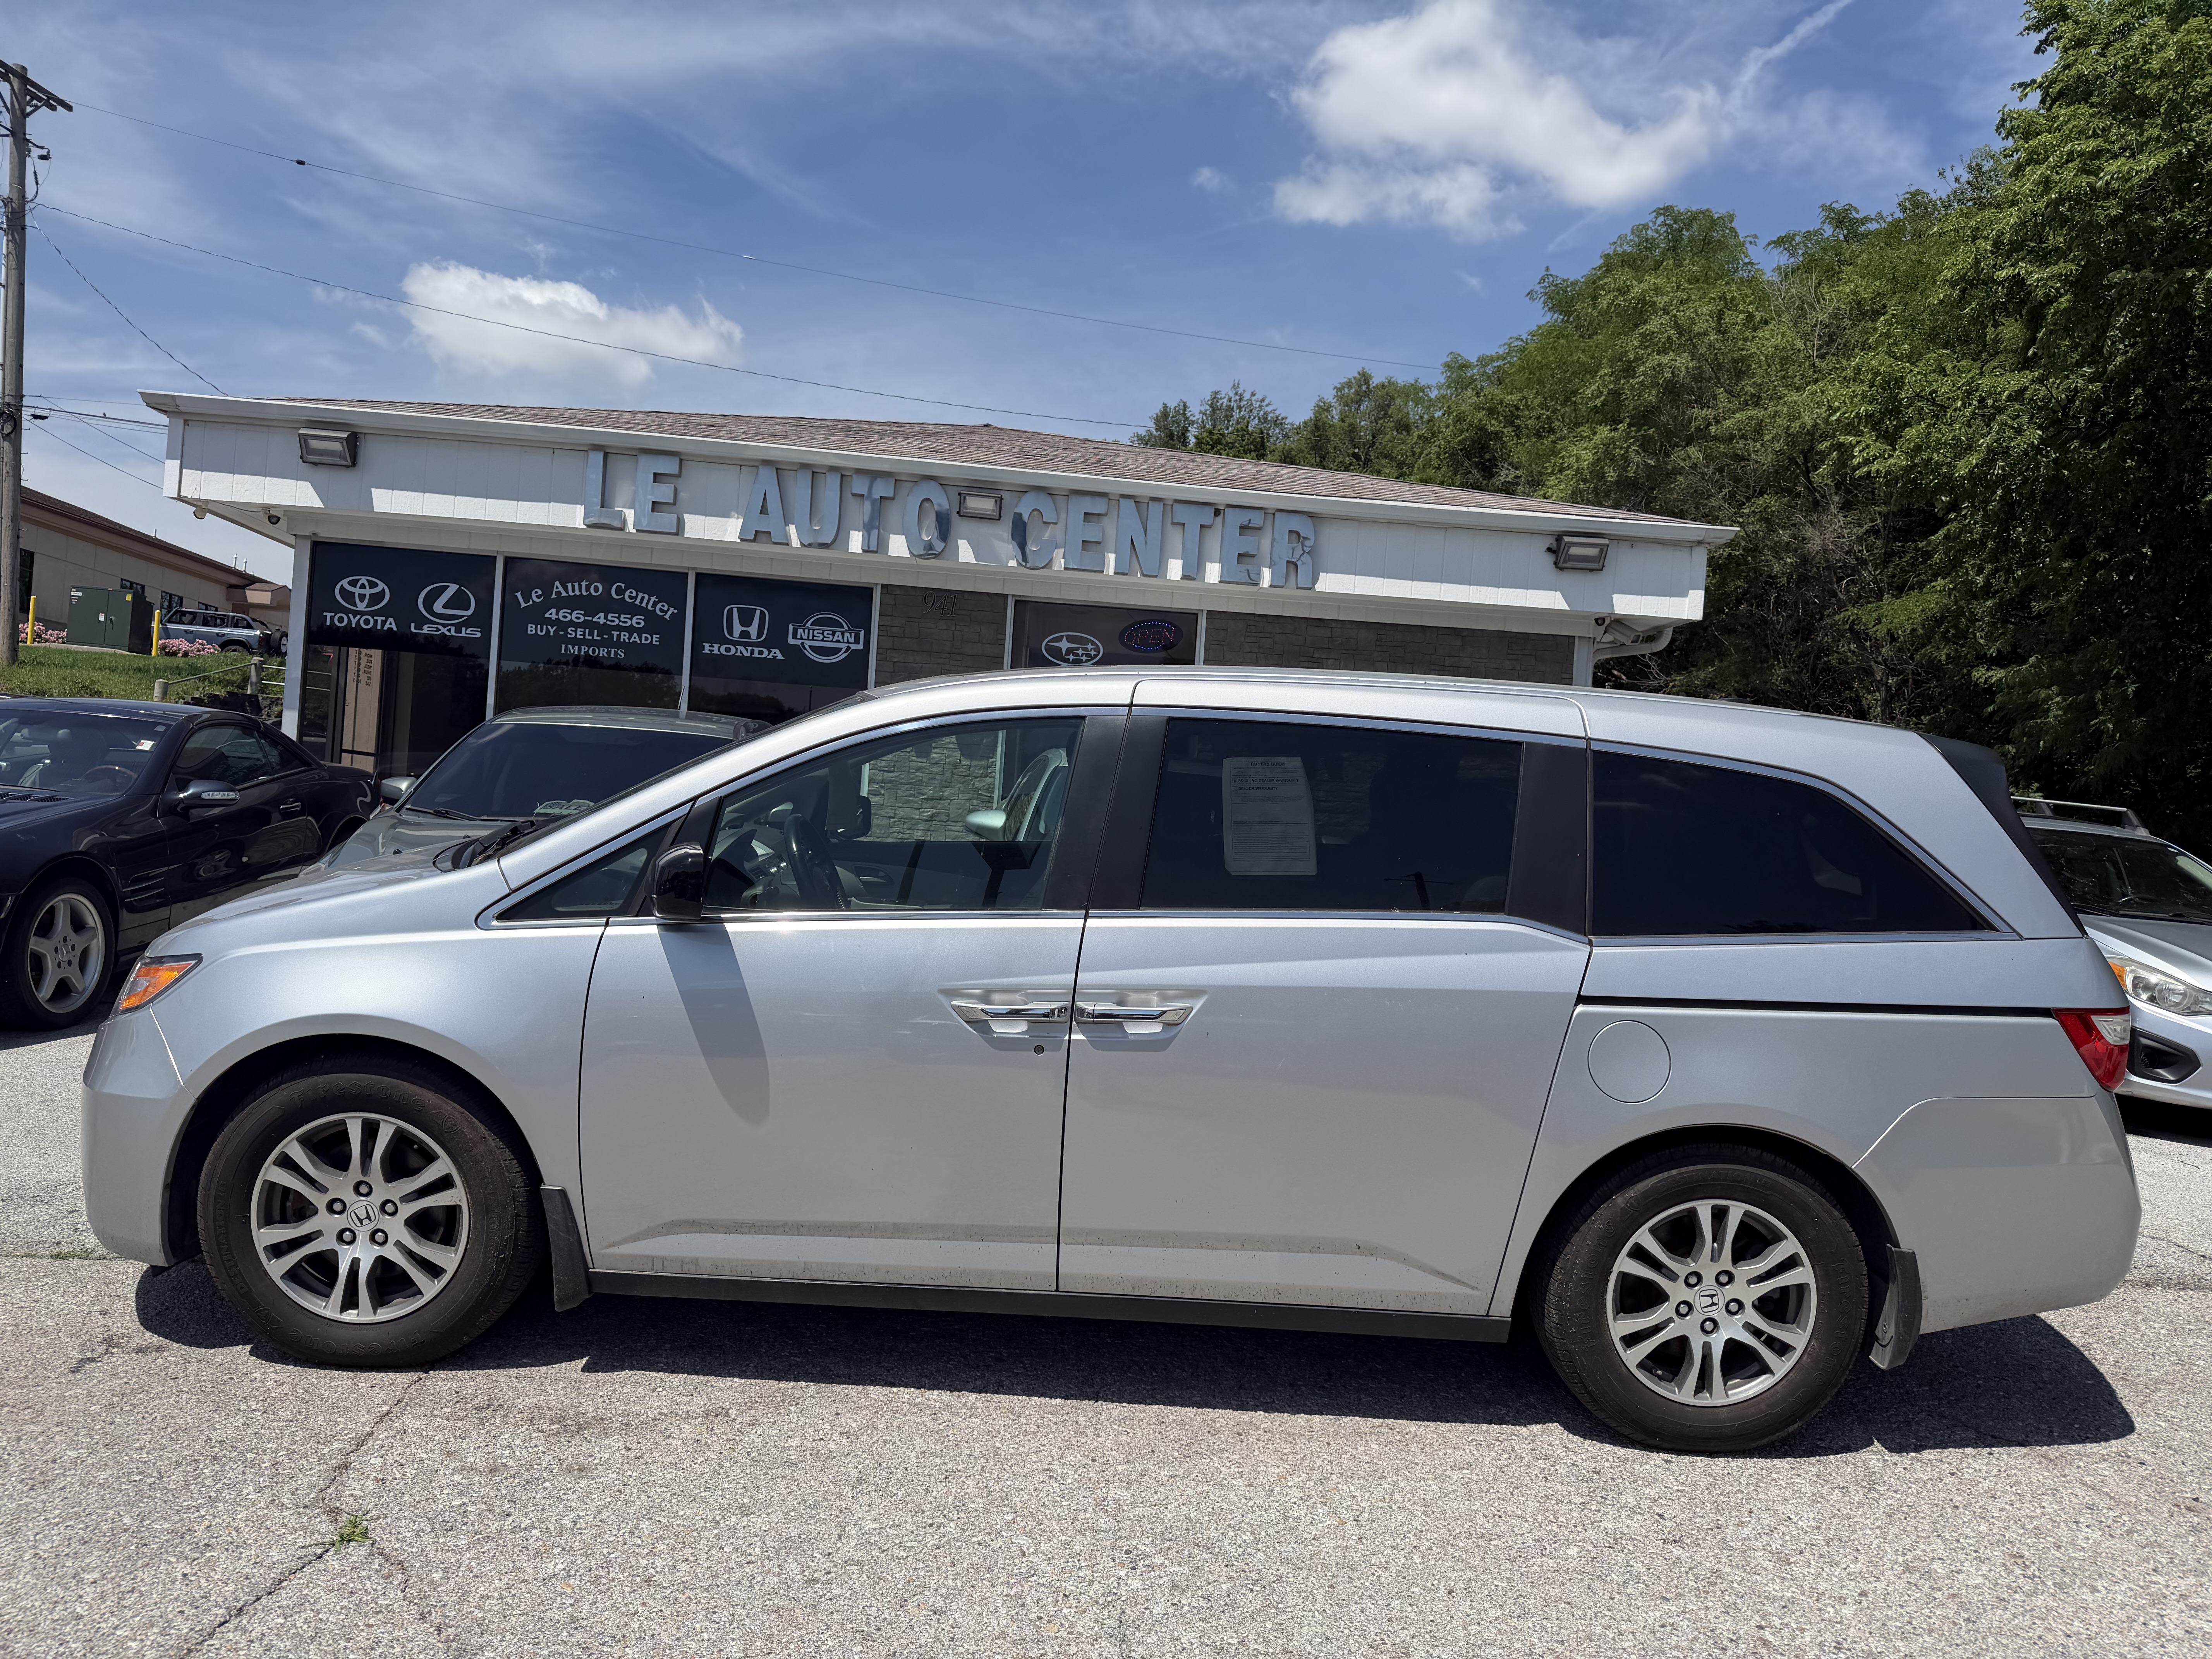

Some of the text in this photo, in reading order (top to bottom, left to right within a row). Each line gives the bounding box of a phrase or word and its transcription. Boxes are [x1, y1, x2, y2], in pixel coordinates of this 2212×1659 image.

[584, 450, 1316, 590] LE AUTO CENTER
[514, 579, 678, 620] Le Auto Center
[922, 591, 958, 617] 941
[323, 612, 397, 631] TOYOTA
[544, 608, 645, 628] 466-4556
[410, 622, 481, 638] LEXUS
[527, 623, 557, 636] BUY
[567, 627, 601, 640] SELL
[611, 631, 660, 645] TRADE
[797, 628, 855, 643] NISSAN
[1125, 628, 1175, 644] OPEN
[561, 644, 625, 659] IMPORTS
[702, 642, 785, 659] HONDA
[289, 1080, 425, 1111] Firestone
[215, 1200, 249, 1294] DESTINATION
[288, 1328, 426, 1357] Firestone
